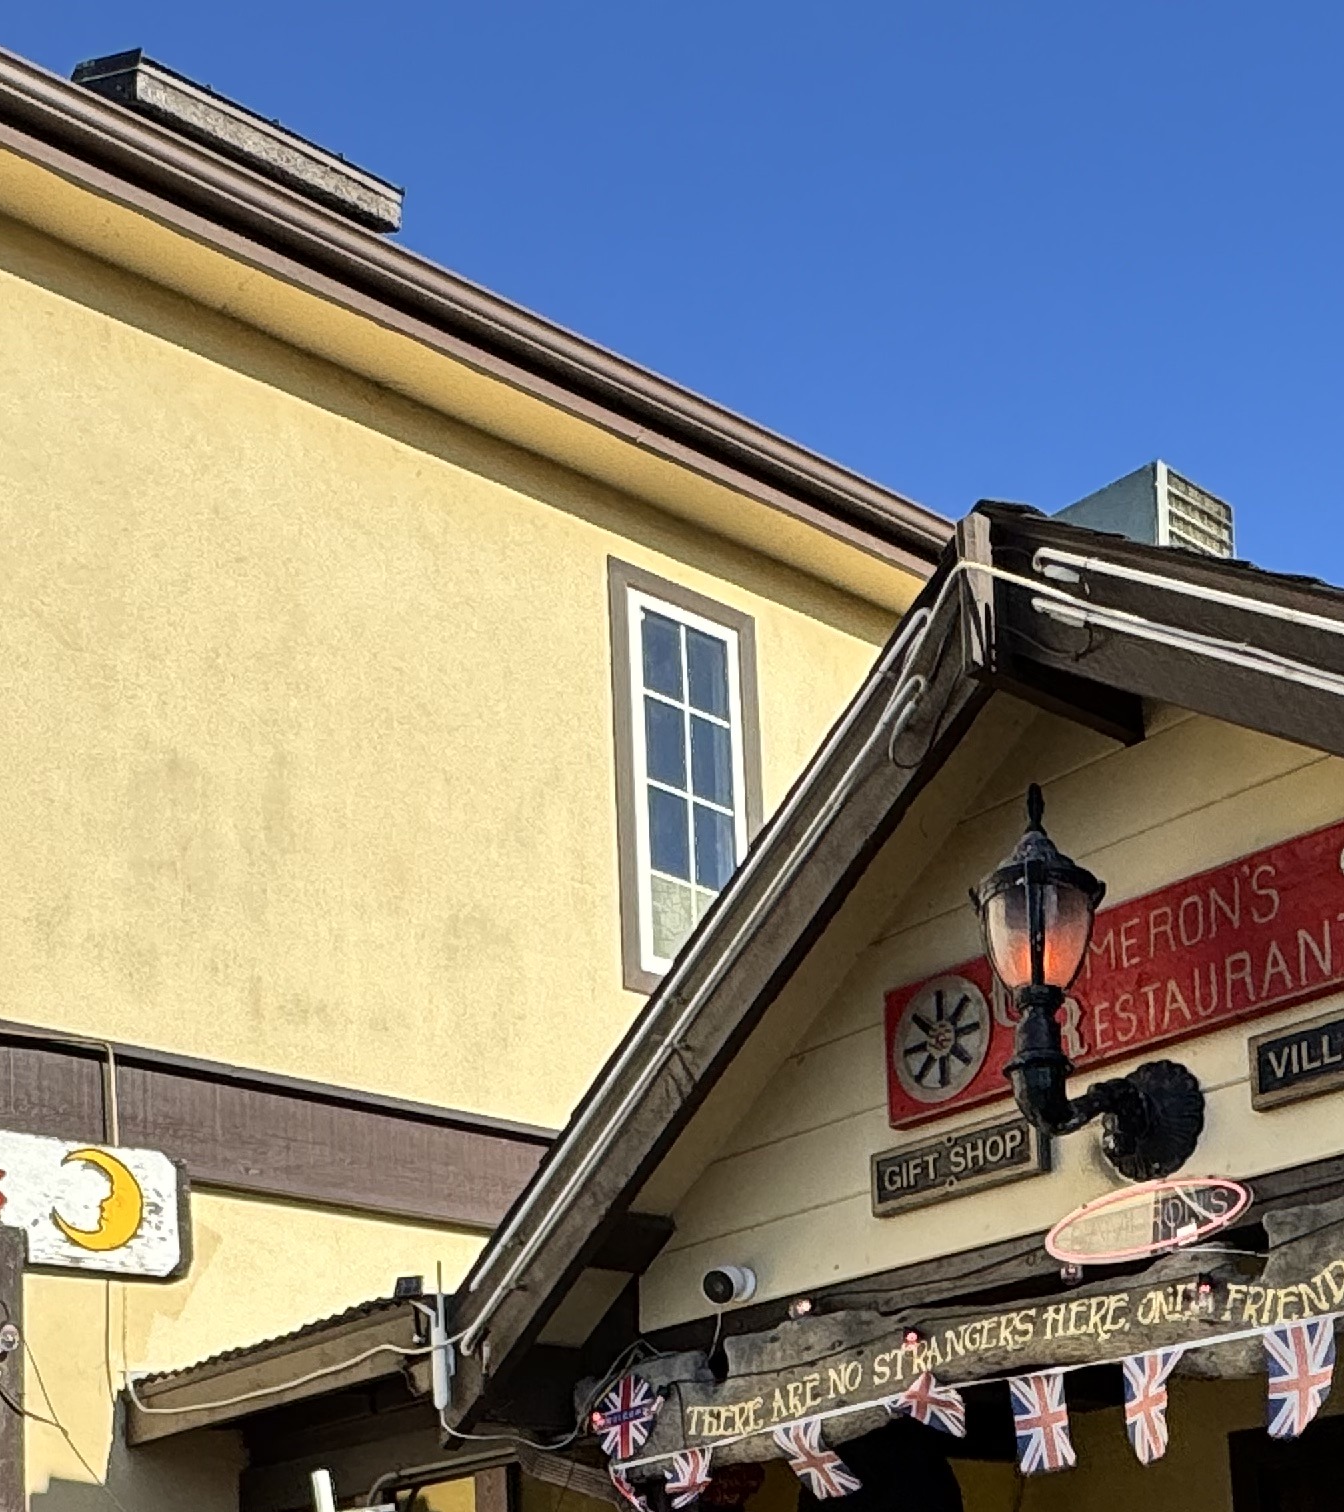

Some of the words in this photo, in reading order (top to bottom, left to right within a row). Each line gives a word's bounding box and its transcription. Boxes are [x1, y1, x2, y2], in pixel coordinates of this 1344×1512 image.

[883, 1155, 940, 1192] GIFT
[949, 1129, 1023, 1174] SHOP
[686, 1398, 765, 1437] THERE
[771, 1377, 823, 1422] ARE
[827, 1361, 864, 1395] NO
[872, 1307, 1035, 1385] STRANGERS
[1137, 1283, 1214, 1326] ONL
